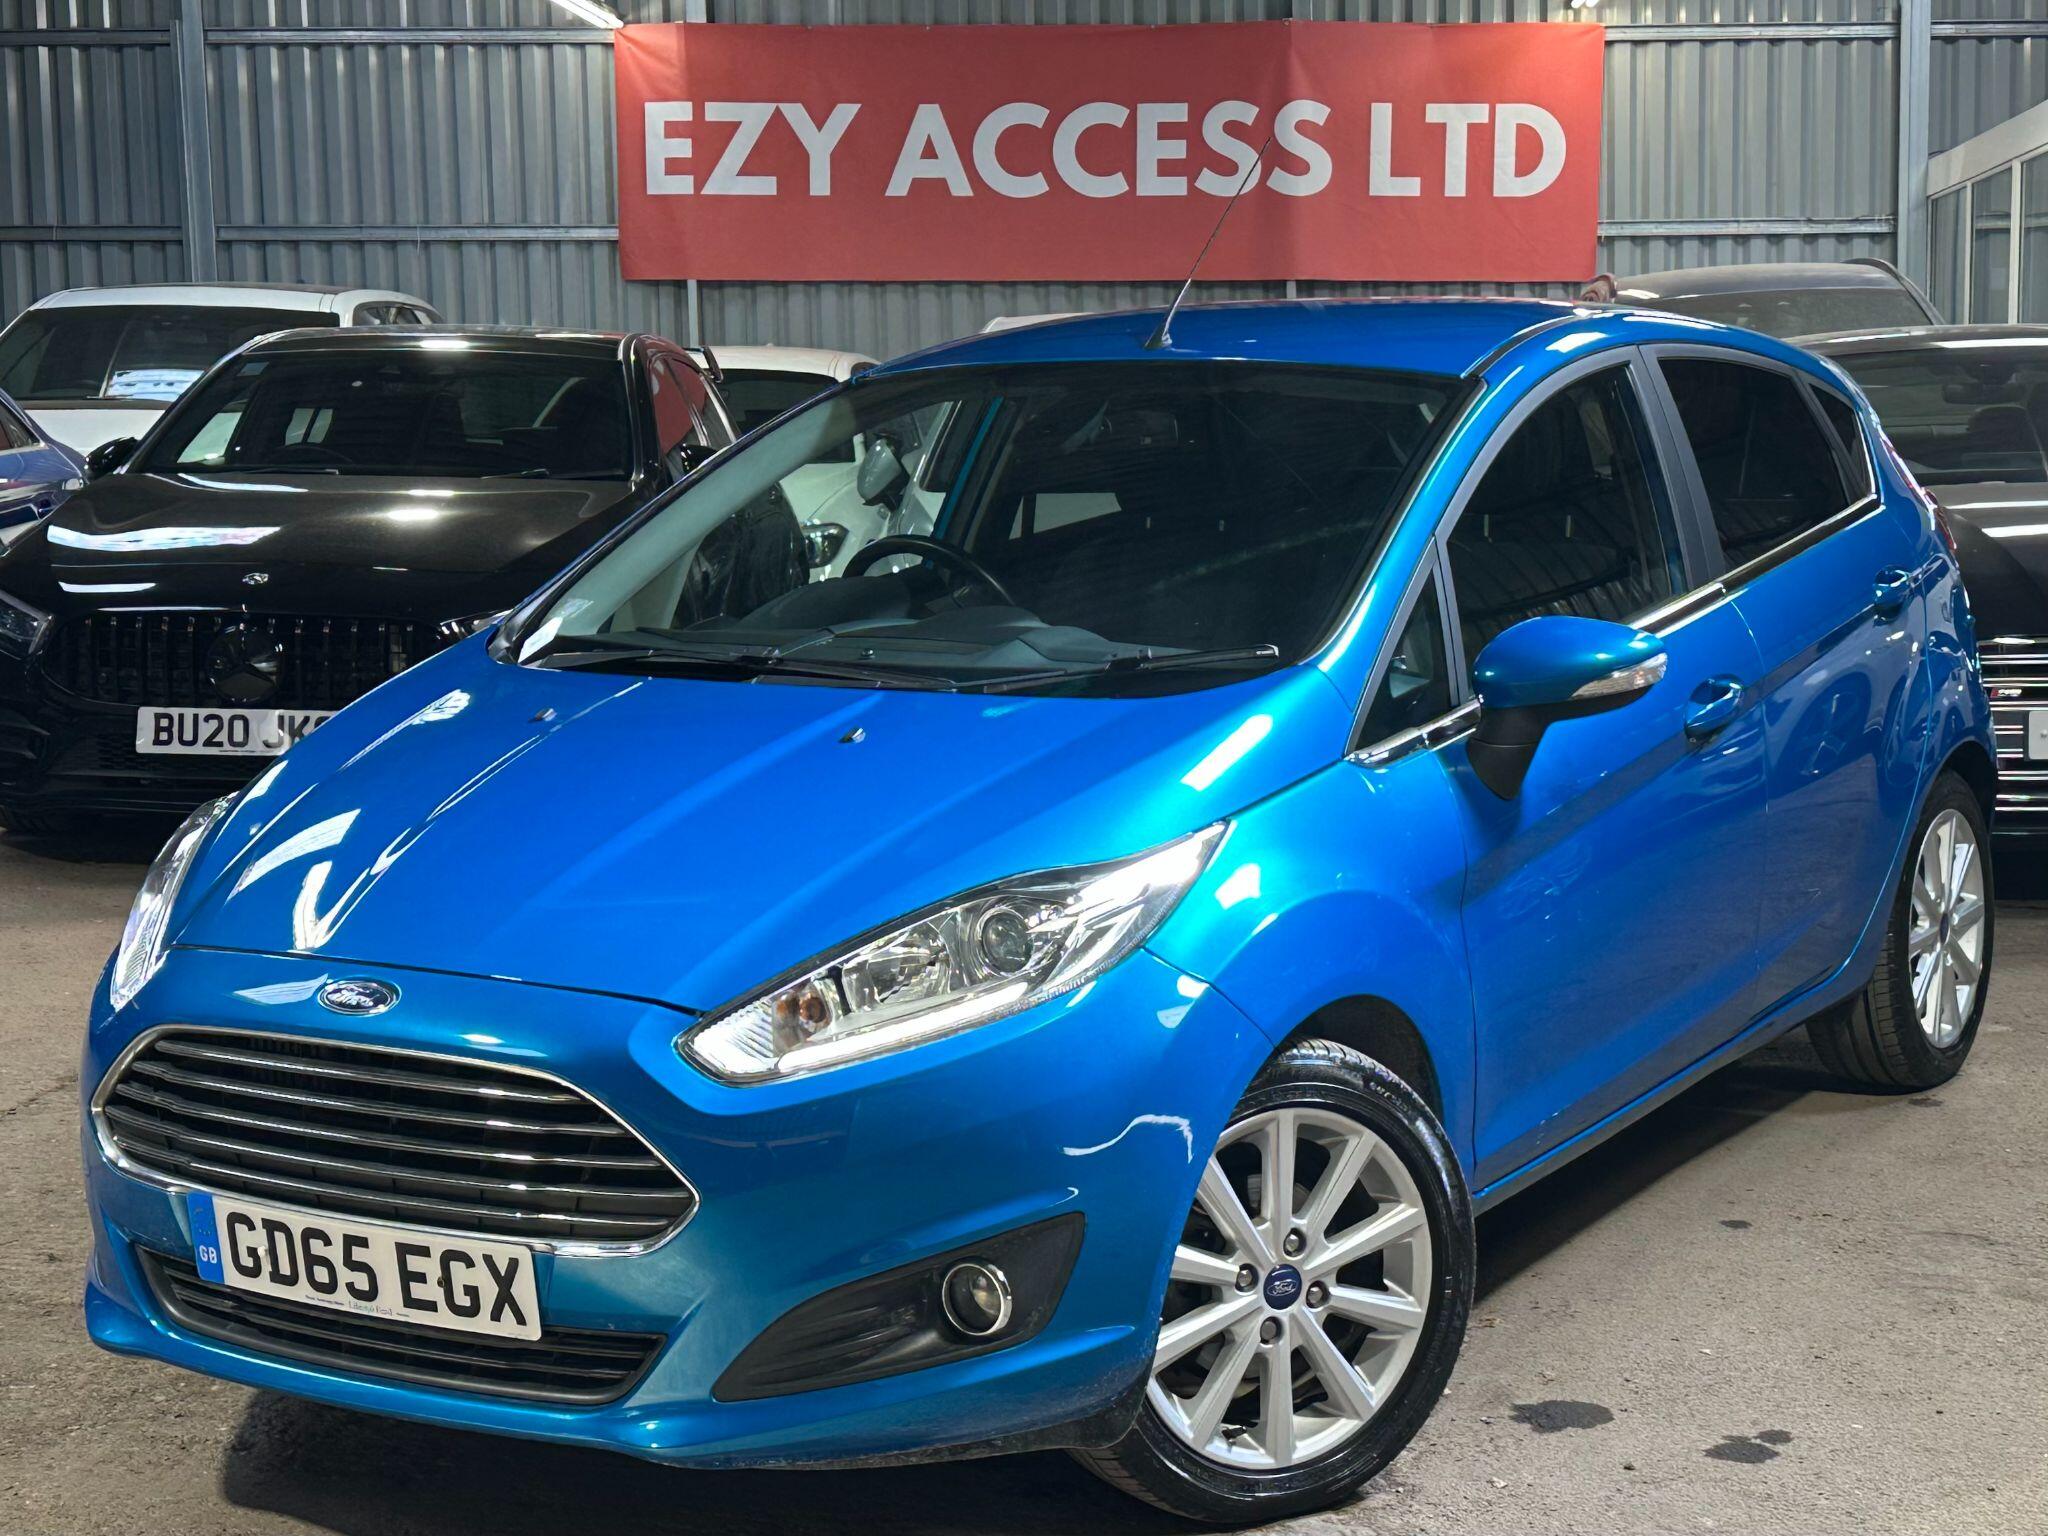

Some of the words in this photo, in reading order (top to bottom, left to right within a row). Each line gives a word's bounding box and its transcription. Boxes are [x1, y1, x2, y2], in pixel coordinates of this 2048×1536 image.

[643, 101, 863, 197] EZY
[884, 99, 1333, 198] ACCESS
[1369, 101, 1567, 198] LTD
[152, 712, 250, 748] BU20
[263, 714, 332, 749] JK
[199, 1244, 218, 1264] GB
[226, 1211, 379, 1302] GD65
[394, 1241, 528, 1327] EGX
